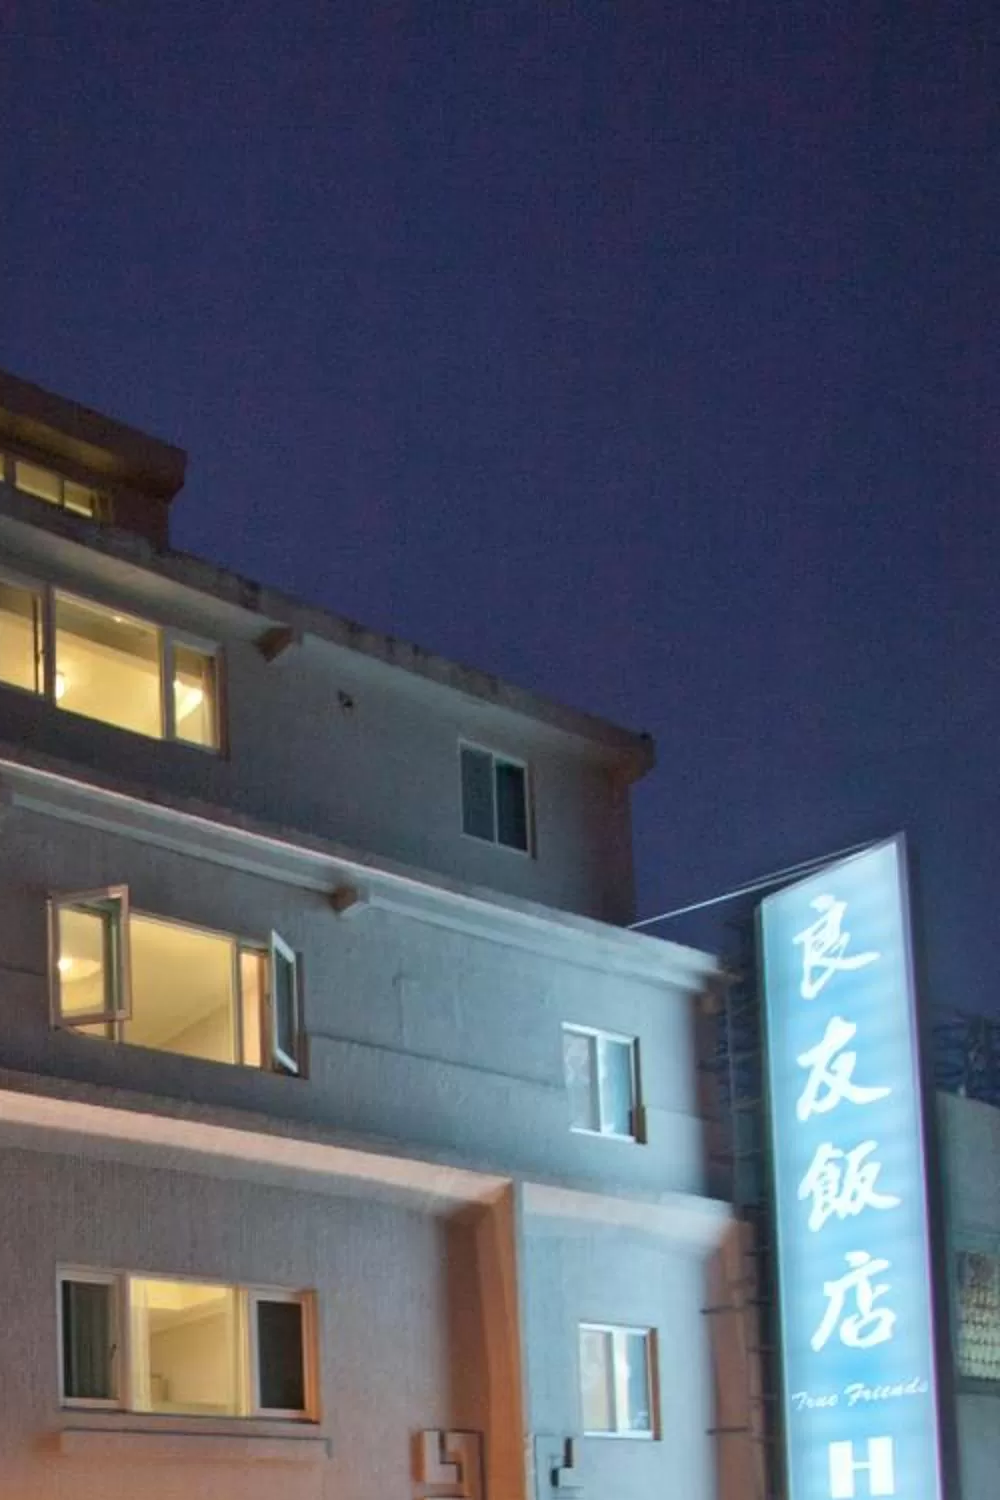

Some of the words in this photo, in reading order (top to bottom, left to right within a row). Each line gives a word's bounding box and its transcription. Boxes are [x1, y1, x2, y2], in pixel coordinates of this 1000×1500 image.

[793, 893, 901, 1352] 良友飯店
[791, 1391, 838, 1411] True
[844, 1376, 928, 1407] Friends
